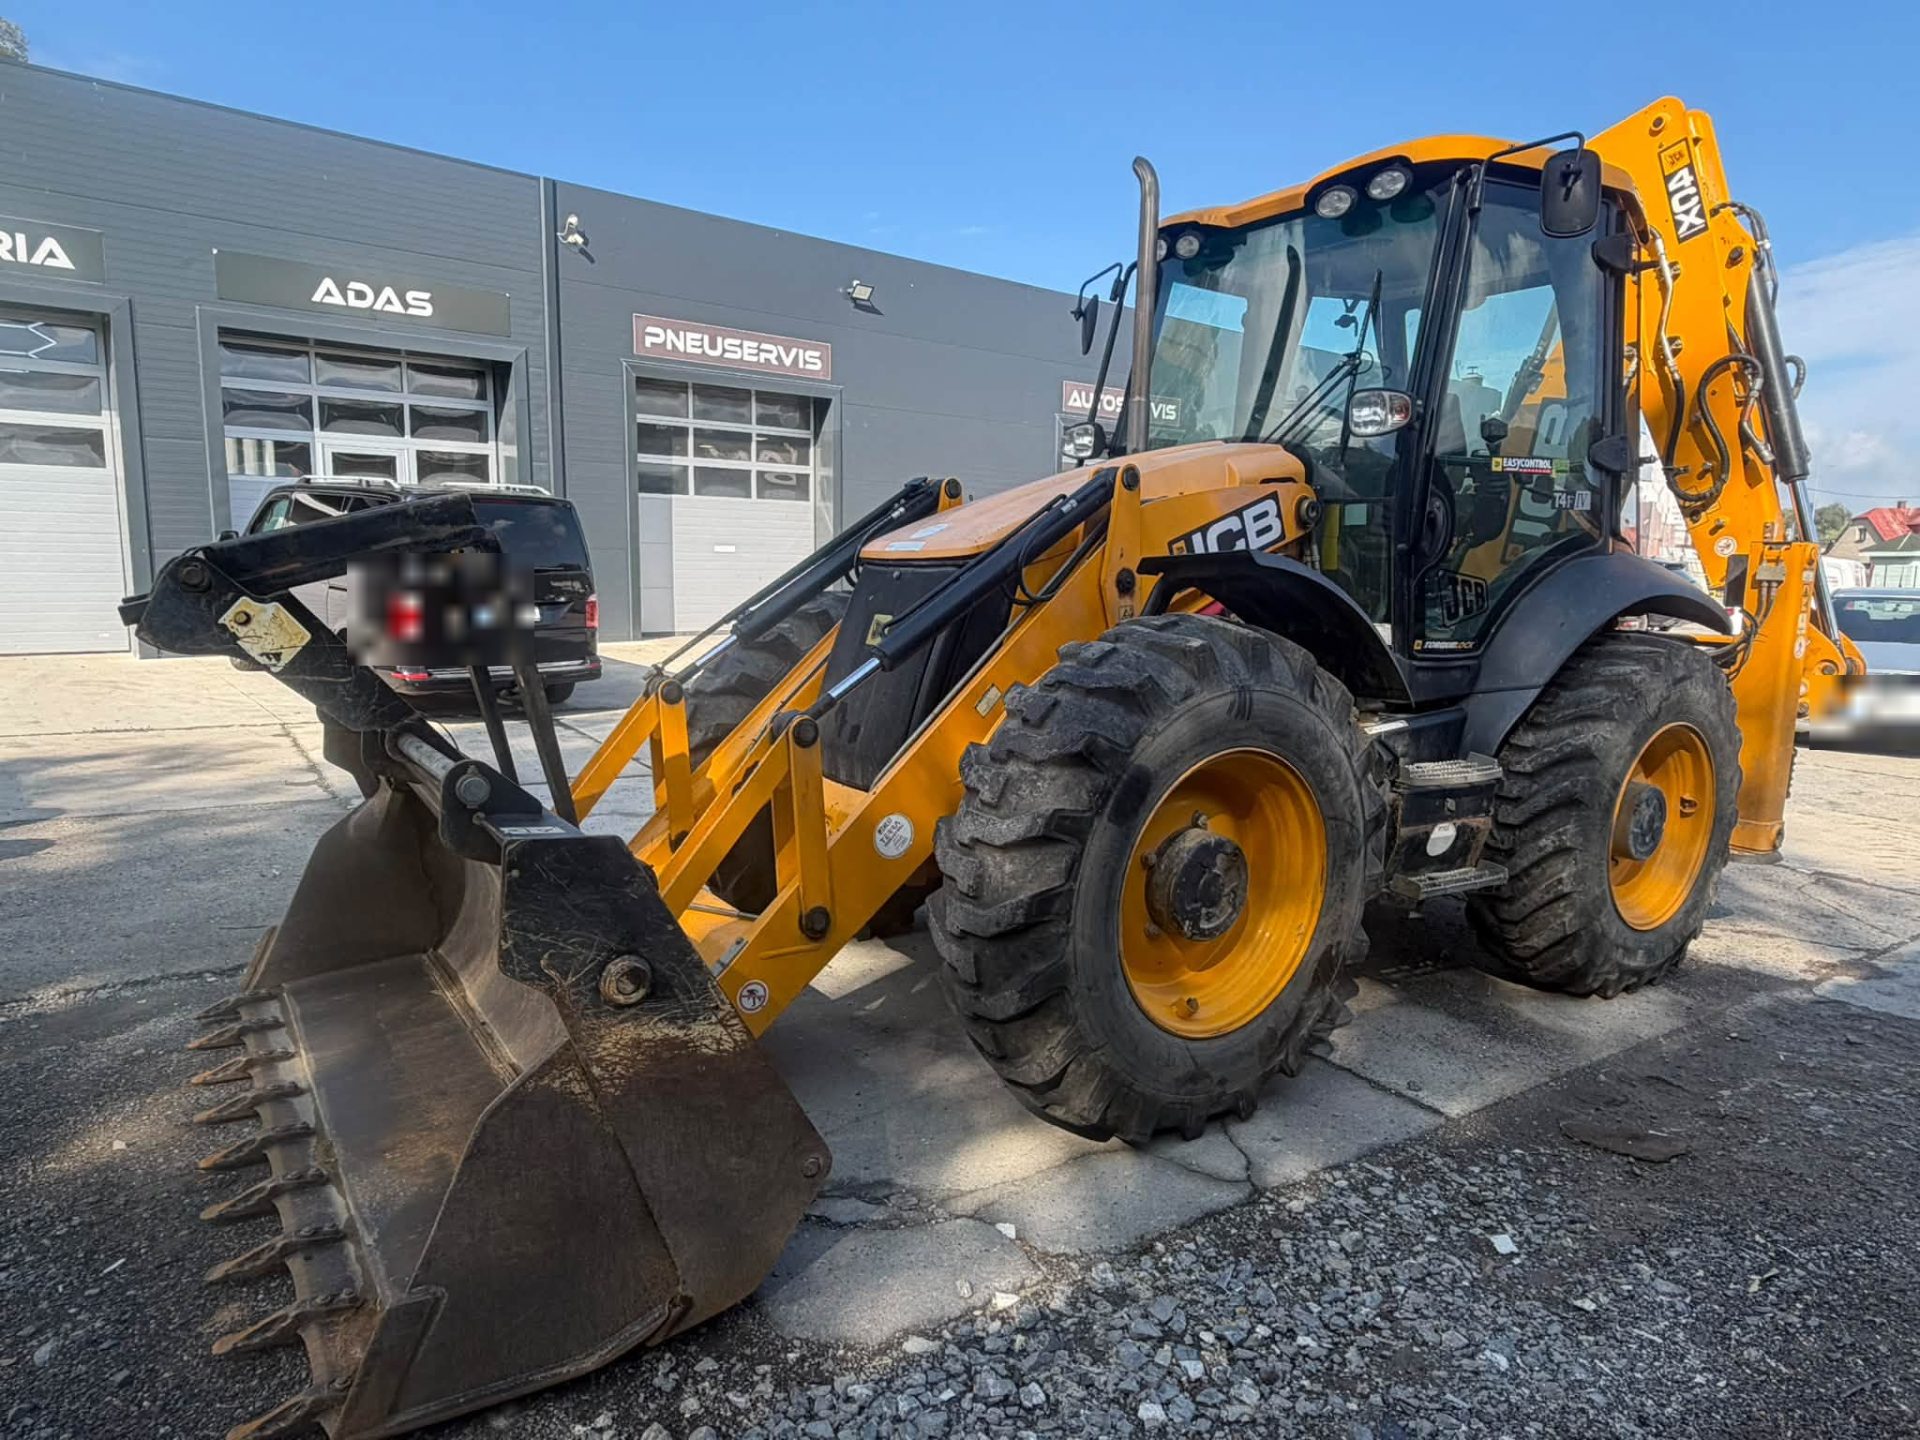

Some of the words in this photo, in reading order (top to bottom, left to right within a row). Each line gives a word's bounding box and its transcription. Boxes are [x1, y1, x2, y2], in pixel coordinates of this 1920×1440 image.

[1668, 167, 1705, 235] 4CX
[311, 277, 433, 316] ADAS
[645, 326, 822, 371] PNEUSERVIS
